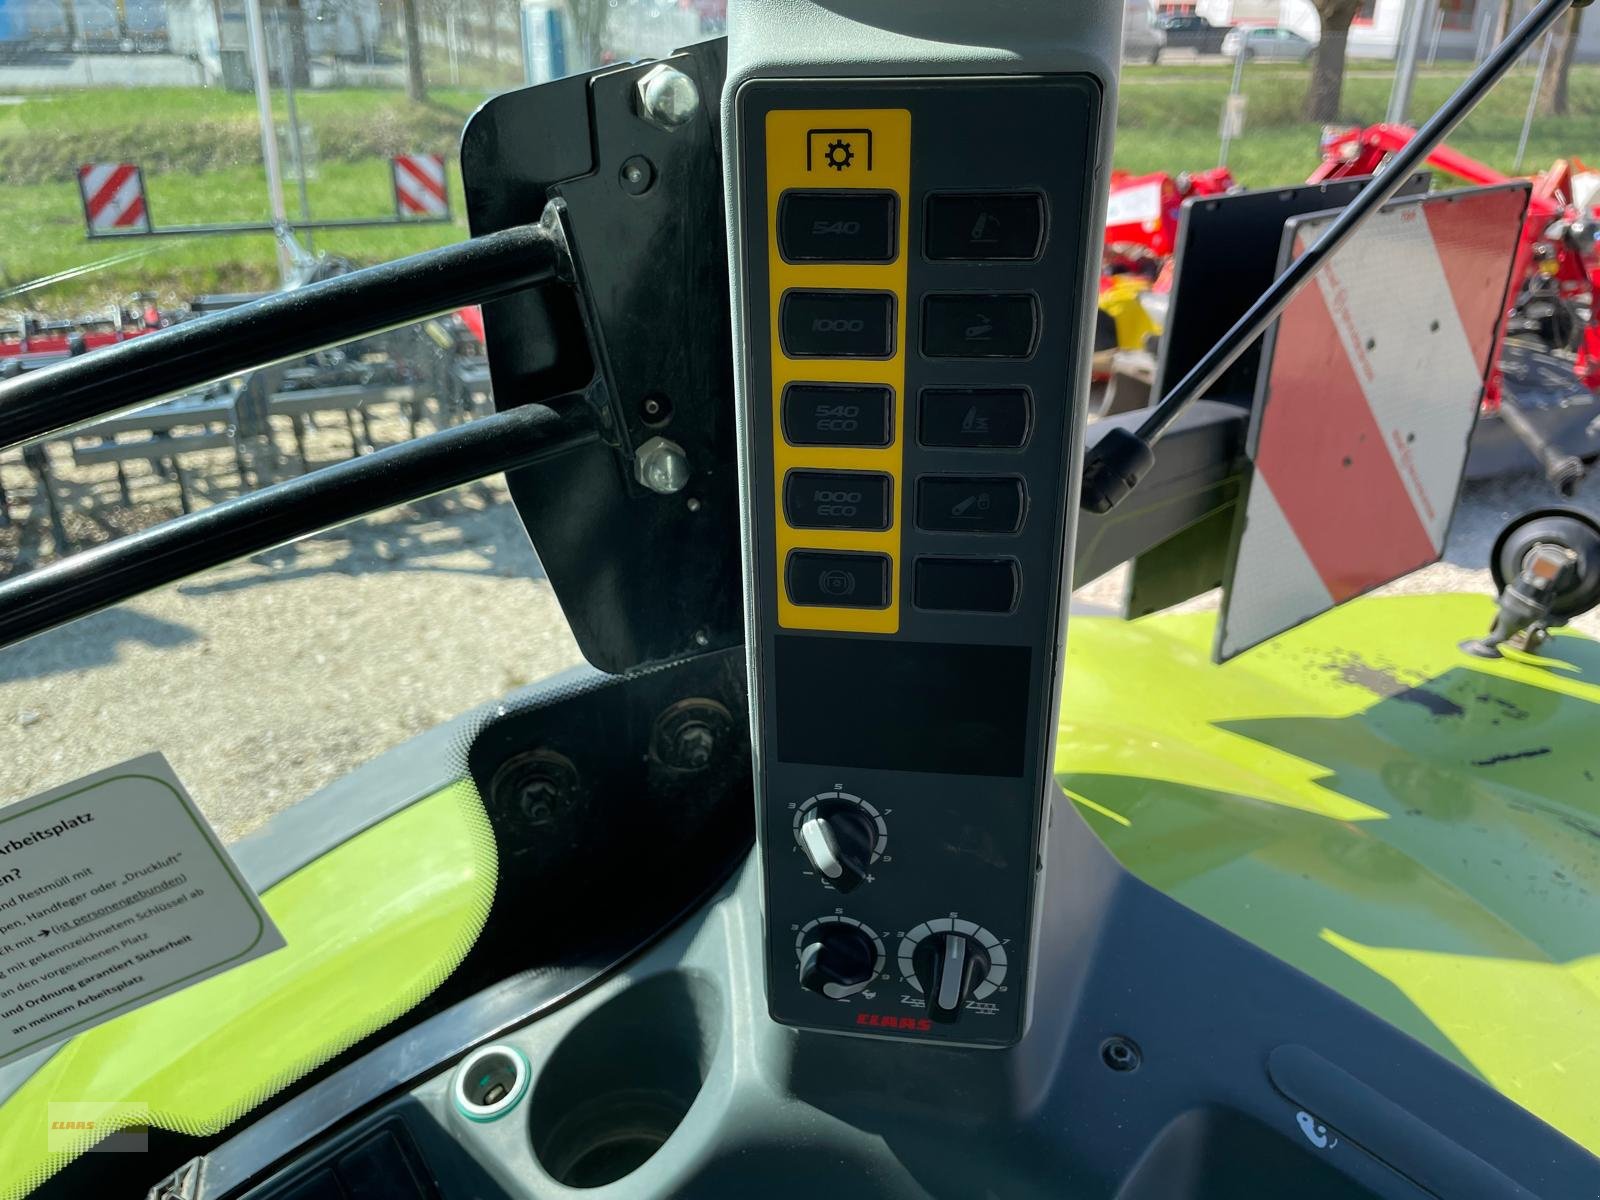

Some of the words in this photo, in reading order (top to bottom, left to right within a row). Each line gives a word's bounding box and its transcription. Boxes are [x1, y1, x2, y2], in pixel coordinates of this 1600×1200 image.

[812, 221, 860, 234] 540
[812, 319, 864, 332] 1000
[815, 405, 859, 418] 540
[816, 420, 858, 432] ECO
[814, 491, 861, 503] 1000
[817, 505, 857, 517] ECO
[883, 808, 893, 816] 7
[0, 896, 18, 913] nd
[17, 875, 71, 903] Restmüll
[72, 867, 93, 881] mit
[26, 891, 88, 922] Handfeger
[90, 880, 117, 897] oder
[7, 961, 28, 975] mit
[28, 917, 136, 967] gekennzeichnetem
[135, 894, 189, 921] Schlüssel
[190, 887, 205, 900] ab
[15, 936, 36, 949] mit
[1, 988, 16, 999] an
[16, 977, 40, 992] den
[40, 944, 121, 981] vorgesehenen
[120, 932, 149, 949] Platz
[1, 1003, 25, 1020] und
[25, 983, 78, 1009] Ordnung
[77, 958, 135, 988] garantiert
[135, 934, 193, 961] Sicherheit
[12, 1024, 28, 1036] an
[28, 1003, 76, 1028] meinem
[76, 975, 145, 1007] Arbeitsplatz
[856, 1012, 934, 1032] CLAAS
